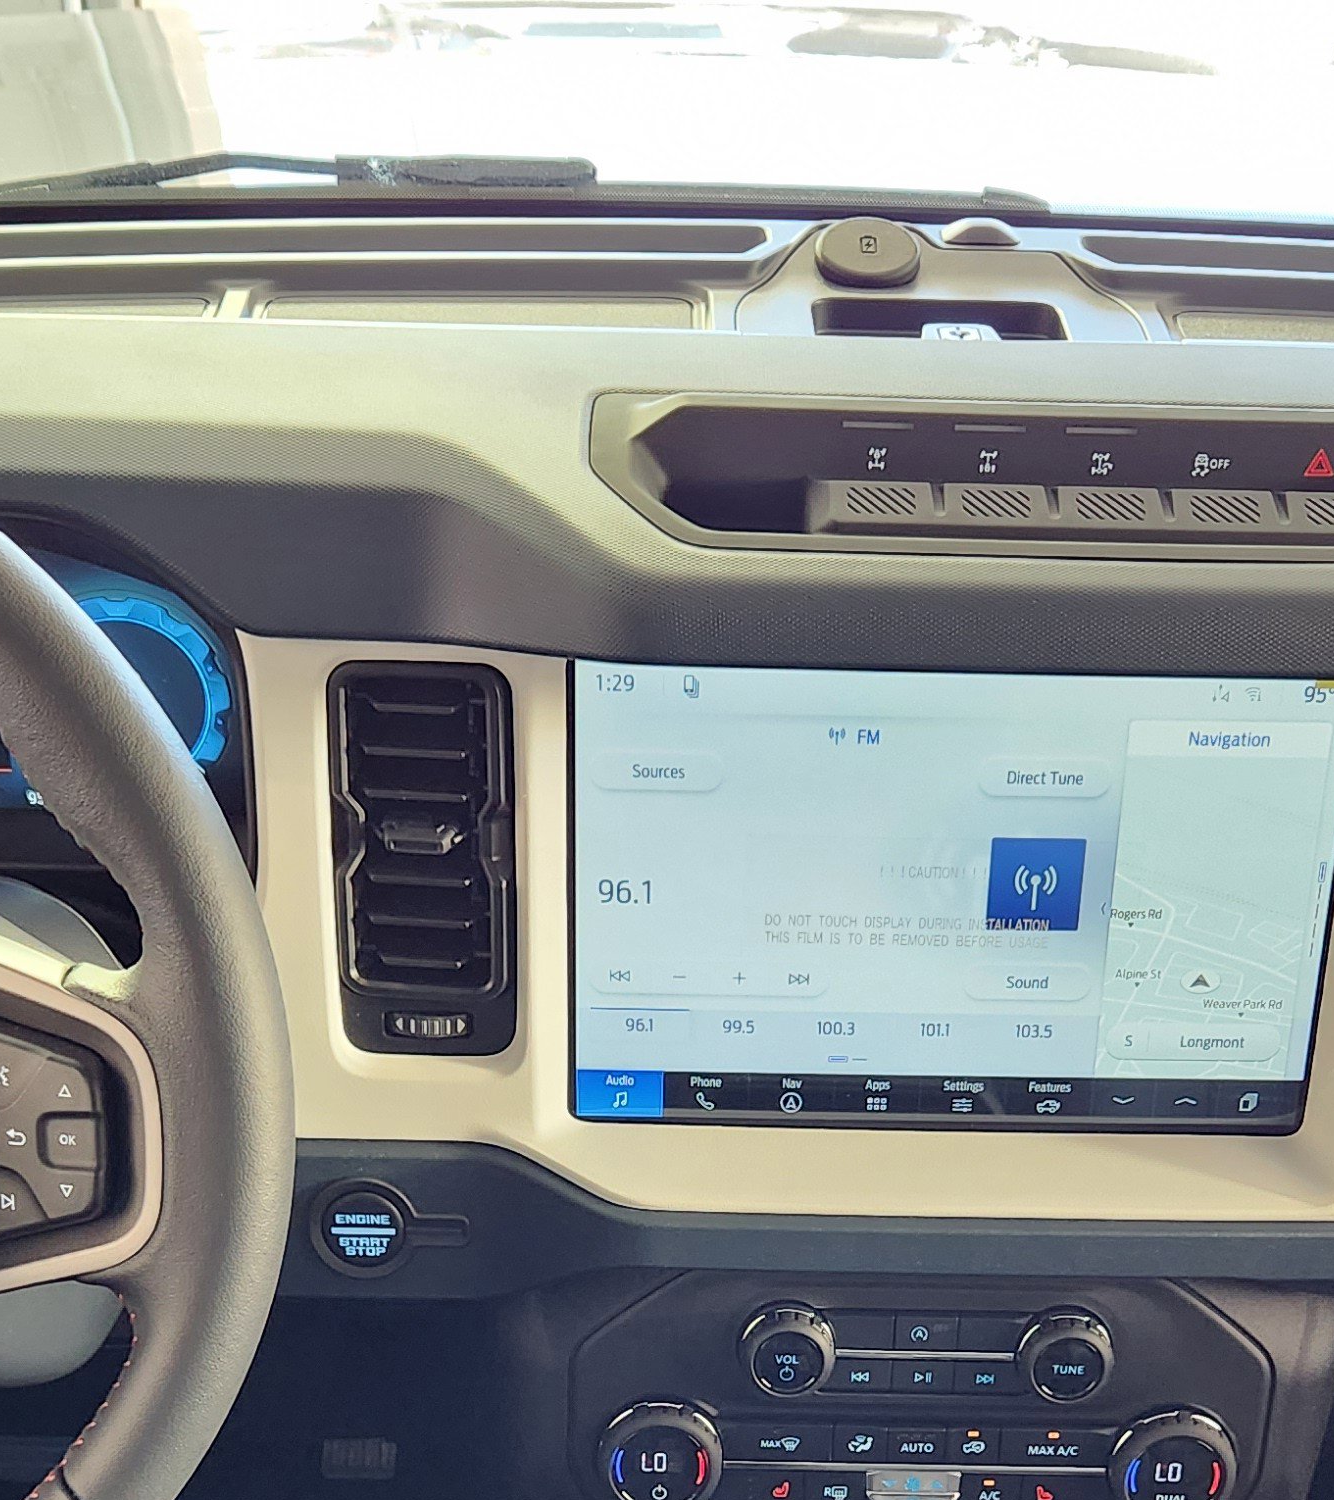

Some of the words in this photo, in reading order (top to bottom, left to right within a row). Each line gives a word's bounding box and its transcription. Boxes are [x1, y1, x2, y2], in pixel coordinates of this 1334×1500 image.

[1209, 458, 1231, 470] OFF
[595, 674, 635, 692] 1:29
[857, 729, 880, 745] FM
[1188, 731, 1272, 750] Navigation
[632, 763, 685, 779] Sources
[1006, 770, 1046, 786] Direct
[1049, 771, 1084, 786] Tune
[598, 879, 653, 905] 96.1
[1110, 908, 1147, 920] Rogers
[1148, 909, 1163, 920] Rd
[764, 914, 782, 927] DO
[787, 914, 812, 928] NOT
[819, 915, 858, 928] TOUCH
[864, 916, 912, 930] DISPLAY
[918, 917, 962, 930] DURING
[968, 918, 1051, 932] INSTALLATION
[765, 931, 790, 944] THIS
[798, 931, 823, 944] FILM
[830, 932, 840, 944] IS
[847, 932, 863, 945] TO
[869, 933, 886, 946] BE
[892, 934, 949, 947] REMOVED
[955, 935, 1003, 948] BEFORE
[1009, 936, 1050, 949] USAGE
[1115, 968, 1149, 980] Alpine
[1150, 969, 1162, 980] St
[1006, 975, 1049, 989] Sound
[1202, 999, 1242, 1010] Weaver
[1243, 1000, 1267, 1010] Park
[1268, 1000, 1283, 1010] Rd
[625, 1018, 654, 1032] 96.1
[722, 1020, 755, 1035] 99.5
[817, 1021, 855, 1036] 100.3
[920, 1023, 950, 1037] 101.1
[1016, 1024, 1053, 1039] 103.5
[1124, 1035, 1133, 1048] S
[1180, 1036, 1245, 1050] Longmont
[605, 1074, 635, 1087] Audio
[690, 1076, 723, 1088] Phone
[782, 1078, 803, 1089] Nav
[865, 1079, 891, 1092] Apps
[943, 1080, 985, 1094] Settings
[1028, 1081, 1072, 1094] Features
[58, 1134, 77, 1146] OK
[335, 1214, 391, 1226] ENGINE
[338, 1236, 391, 1247] START
[345, 1245, 387, 1257] STOP
[775, 1354, 800, 1365] VOL
[1052, 1364, 1086, 1375] TUNE
[760, 1439, 781, 1449] MAX
[900, 1442, 934, 1453] AUTO
[1027, 1445, 1054, 1456] MAX
[1056, 1445, 1079, 1457] A/C
[641, 1452, 667, 1472] LO
[1154, 1462, 1183, 1483] LO
[979, 1490, 1001, 1500] A/C
